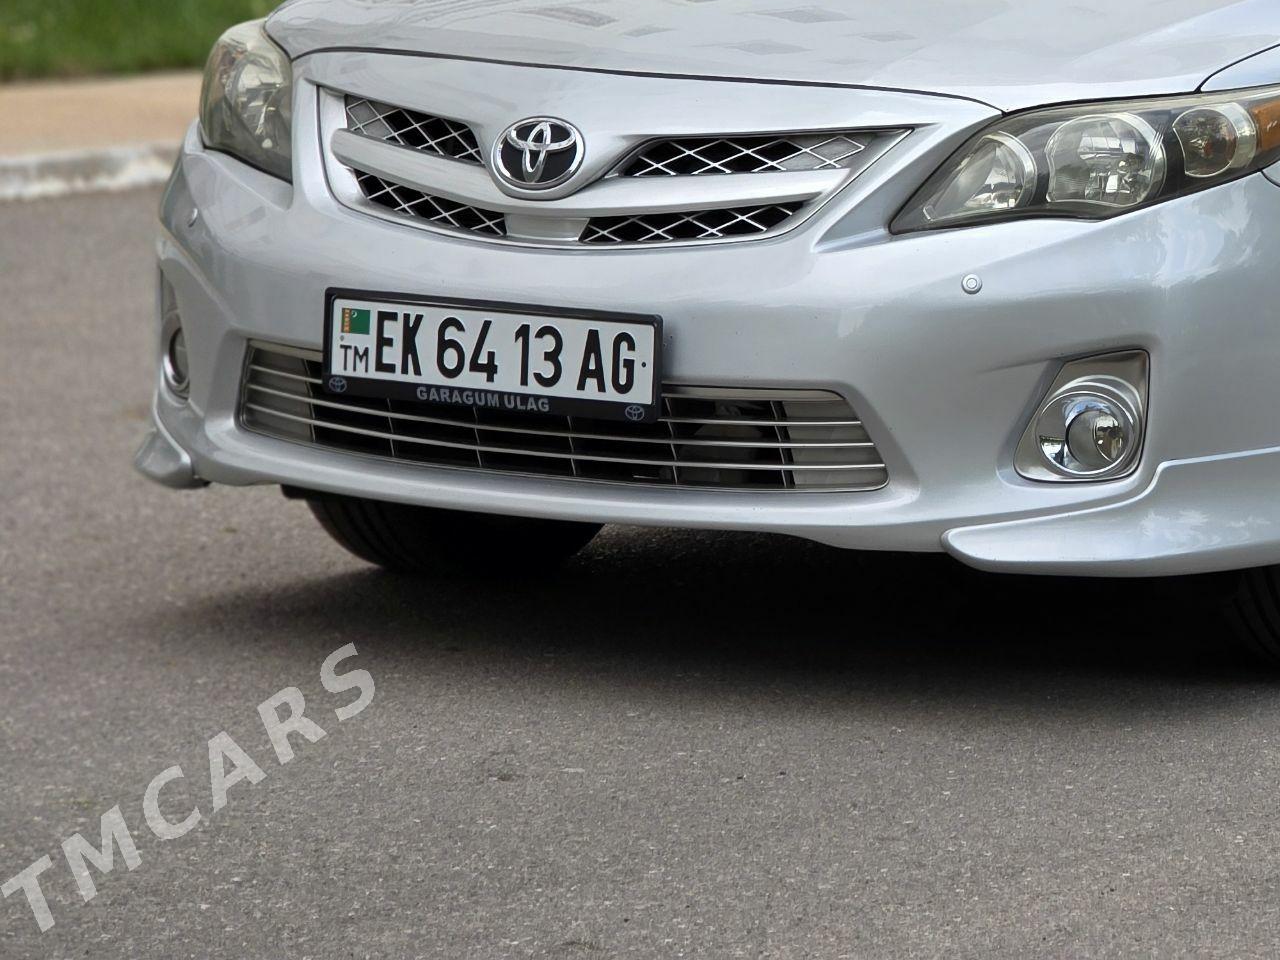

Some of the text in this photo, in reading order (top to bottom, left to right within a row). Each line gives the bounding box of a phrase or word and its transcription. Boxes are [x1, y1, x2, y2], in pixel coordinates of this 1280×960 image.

[340, 344, 369, 373] TM
[375, 311, 636, 394] EK 64 13 AG
[416, 386, 549, 412] GARAGUM ULAG
